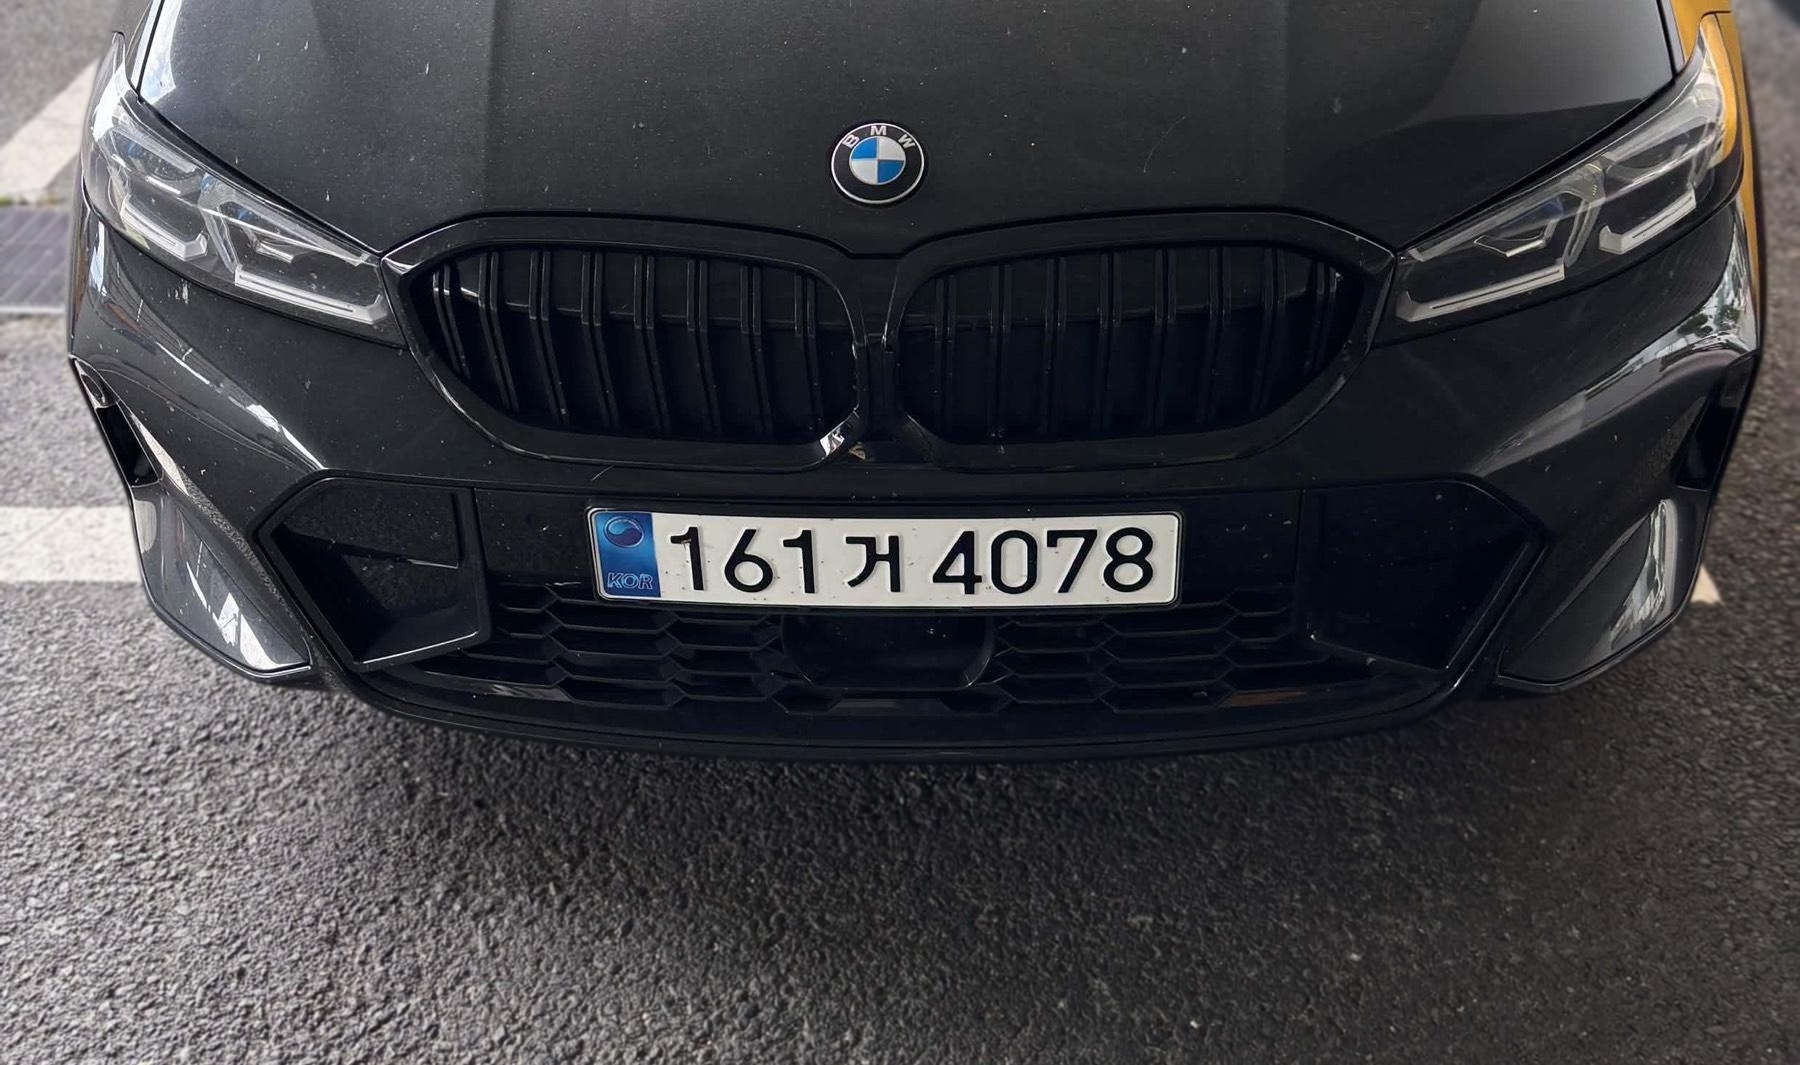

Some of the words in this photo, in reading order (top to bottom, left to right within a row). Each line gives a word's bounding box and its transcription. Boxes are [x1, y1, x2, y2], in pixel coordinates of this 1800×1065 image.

[842, 125, 916, 149] BMW
[669, 526, 902, 594] 161거
[932, 527, 1155, 595] 4078
[607, 572, 654, 590] KOR
